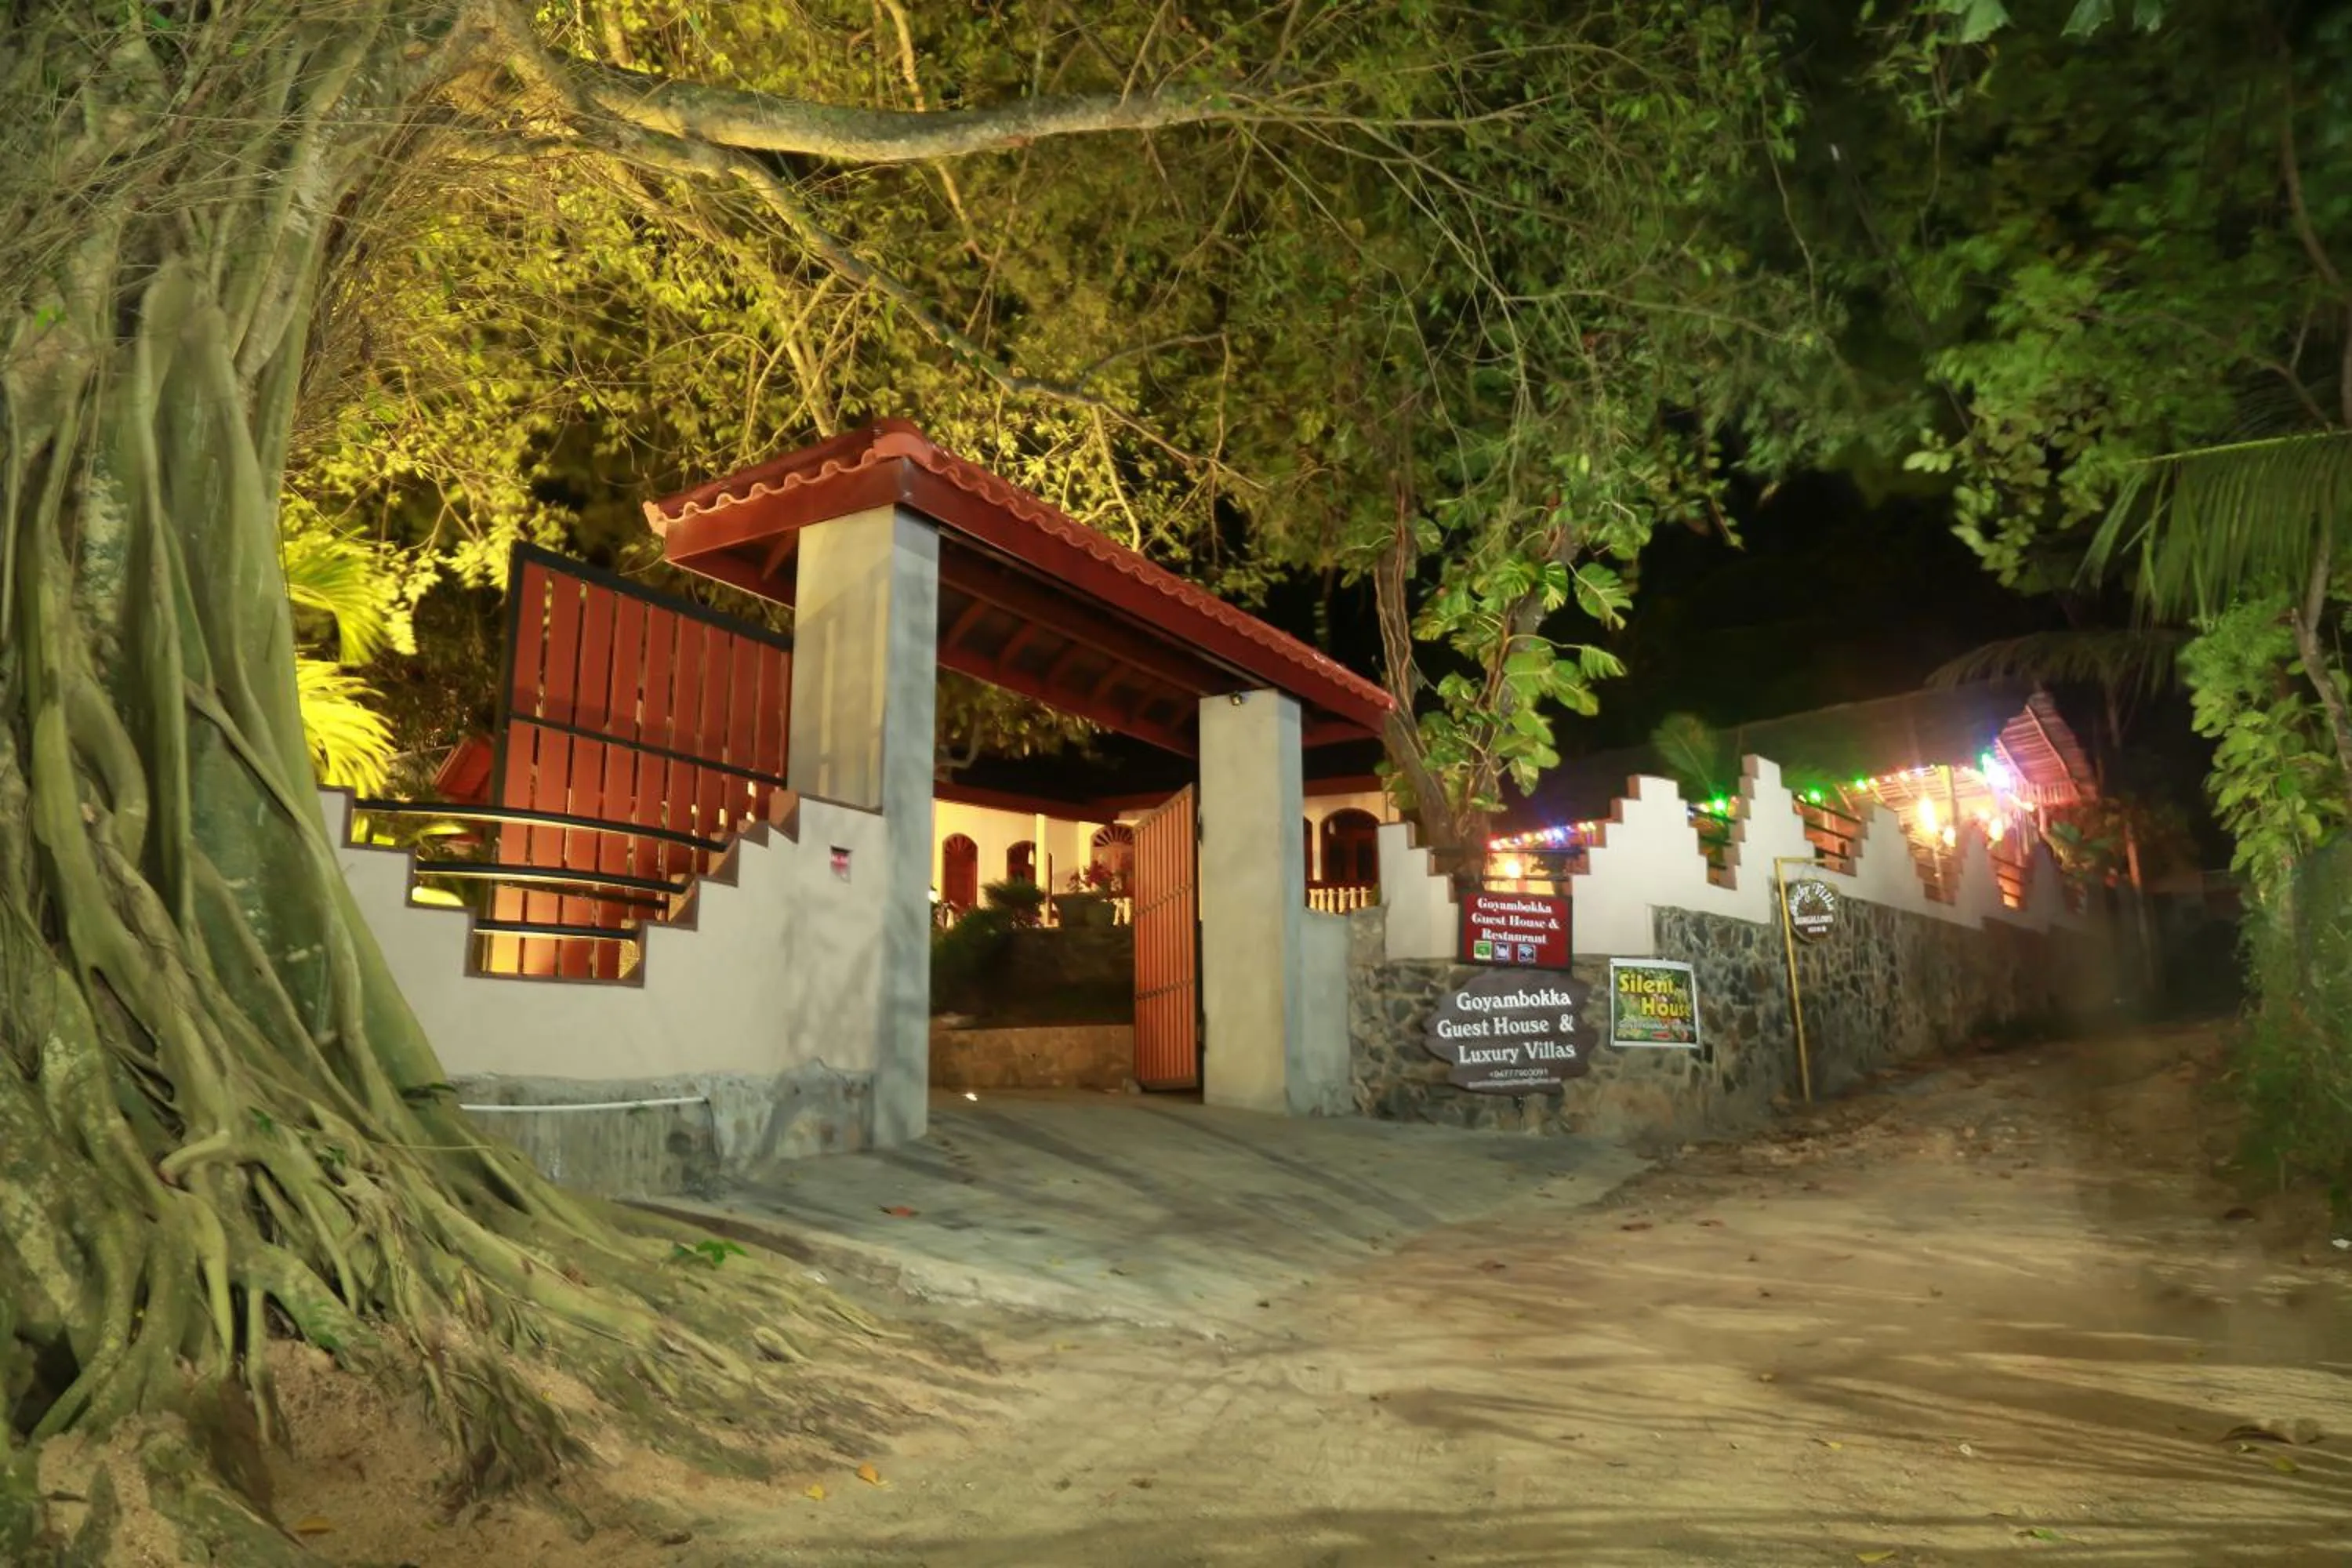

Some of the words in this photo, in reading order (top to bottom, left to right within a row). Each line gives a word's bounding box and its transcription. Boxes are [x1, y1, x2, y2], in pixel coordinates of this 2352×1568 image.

[1477, 897, 1552, 914] Goyambokka
[1471, 912, 1506, 926] Guest
[1509, 915, 1547, 929] House
[1548, 917, 1560, 930] &
[1481, 927, 1548, 945] Restaurant
[1619, 974, 1675, 993] Silent
[1456, 988, 1573, 1014] Goyambokka
[1436, 1018, 1490, 1039] Guest
[1492, 1015, 1551, 1036] House
[1559, 1013, 1575, 1033] &
[1457, 1044, 1519, 1065] Luxury
[1524, 1040, 1577, 1060] Villas
